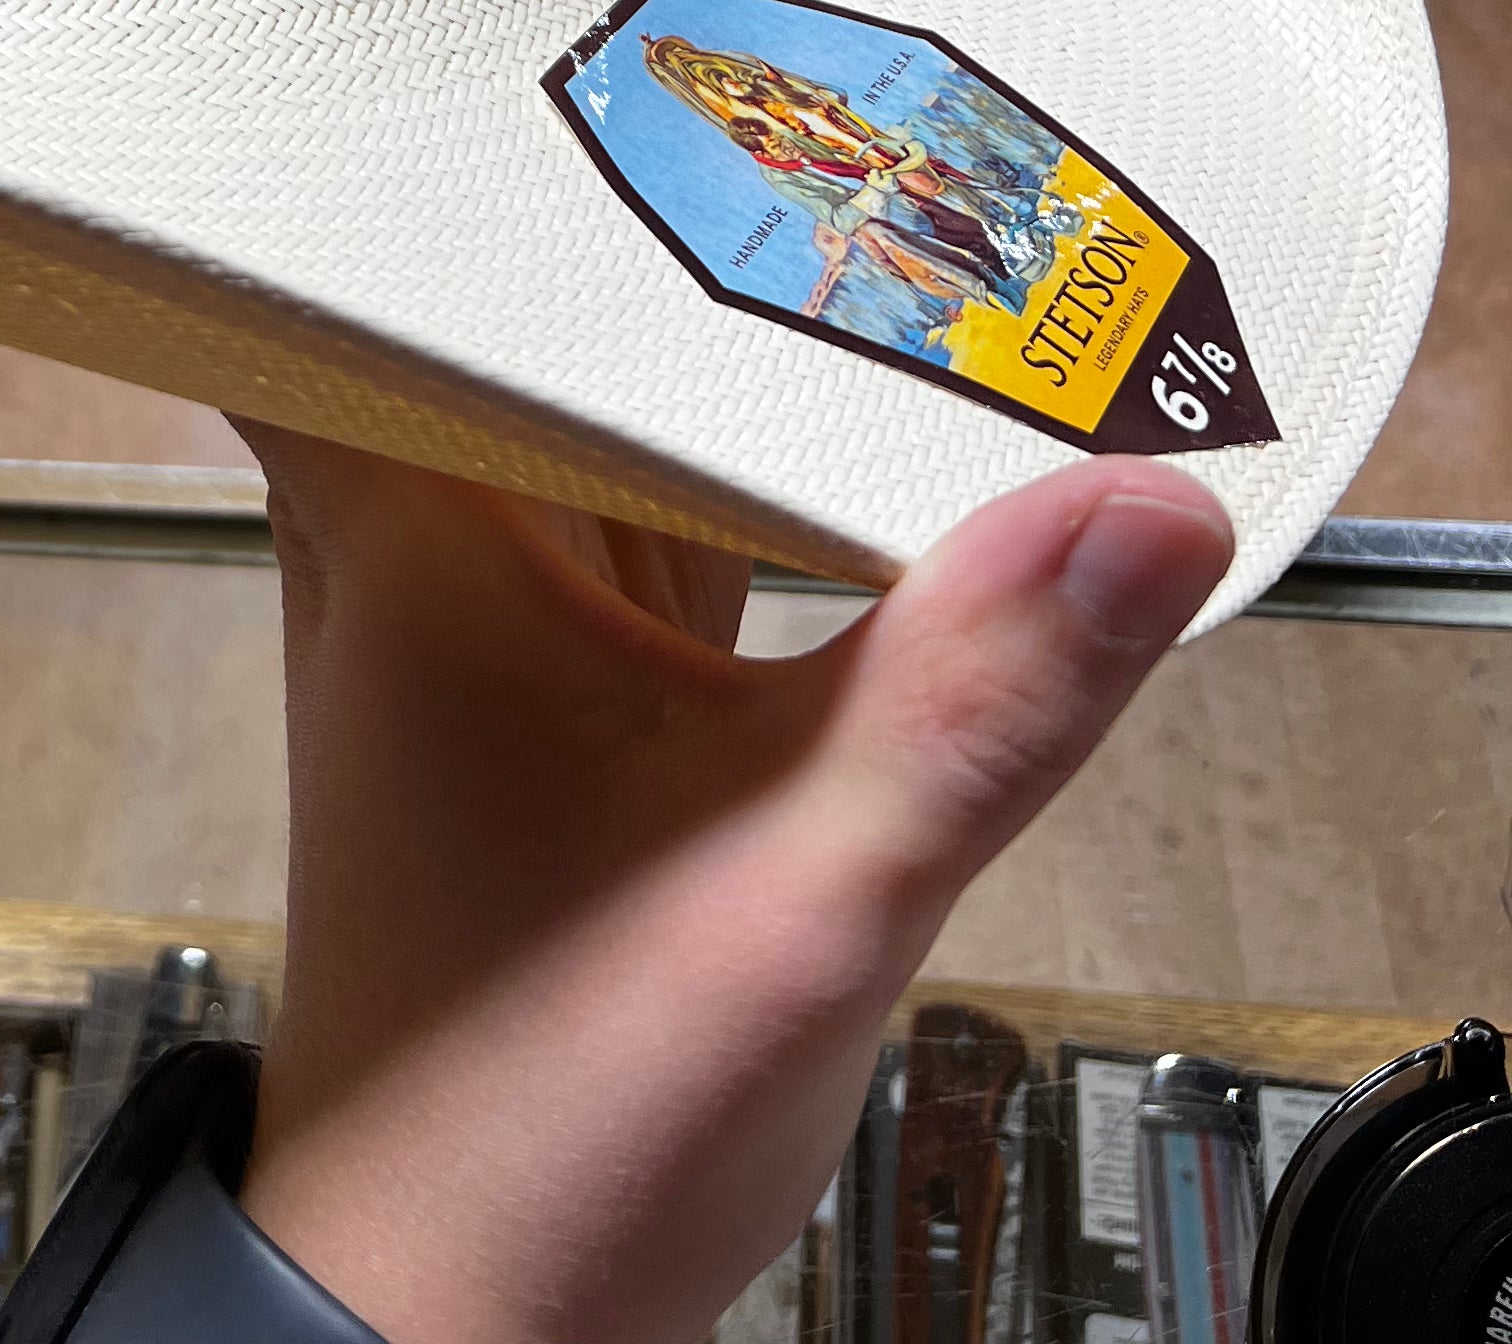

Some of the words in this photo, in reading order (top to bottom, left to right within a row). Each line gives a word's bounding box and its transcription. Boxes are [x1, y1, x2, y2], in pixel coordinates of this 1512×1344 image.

[885, 51, 917, 76] U.S.A.
[870, 72, 896, 94] THE
[862, 89, 881, 106] IN
[728, 204, 789, 270] HANDMADE
[1093, 310, 1135, 372] LEGENDARY
[1125, 285, 1149, 316] HATS
